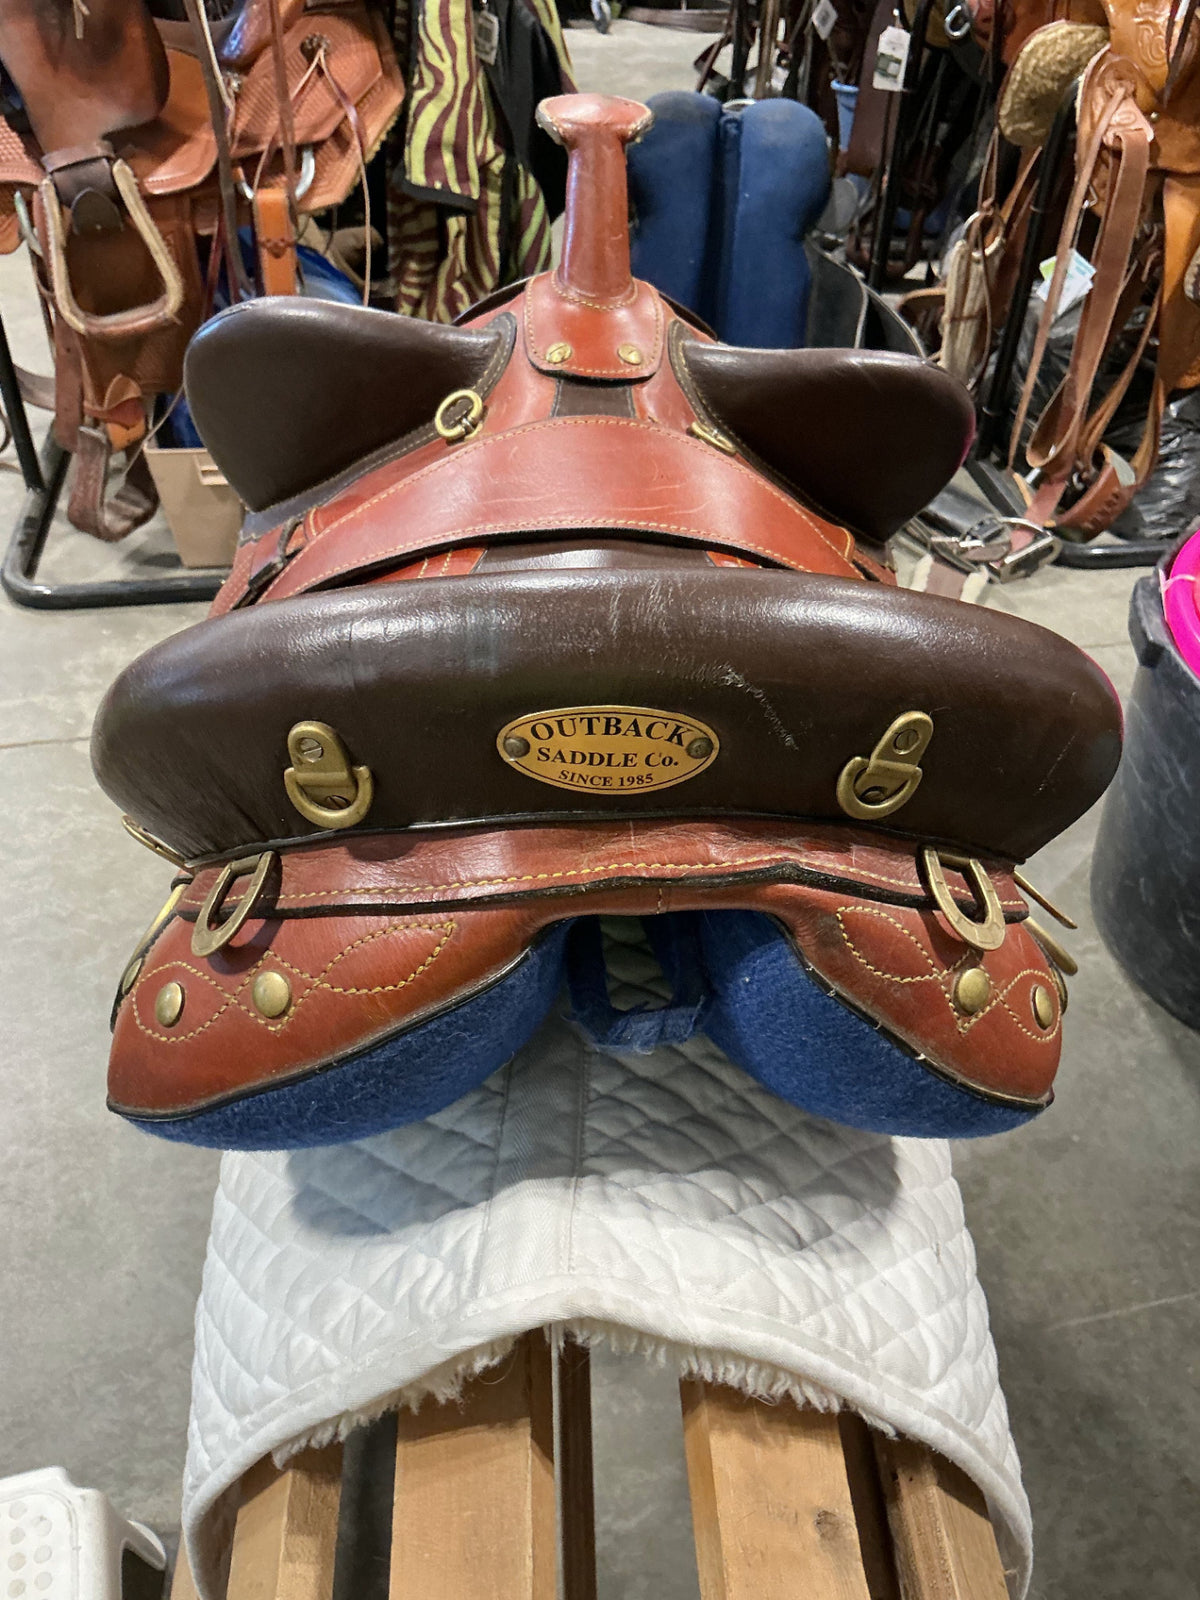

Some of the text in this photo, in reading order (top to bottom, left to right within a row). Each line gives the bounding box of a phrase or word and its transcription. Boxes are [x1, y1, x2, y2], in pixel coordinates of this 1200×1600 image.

[530, 716, 693, 747] OUTBACK
[537, 746, 679, 768] SADDLE Co.
[558, 769, 654, 787] SINCE 1985
